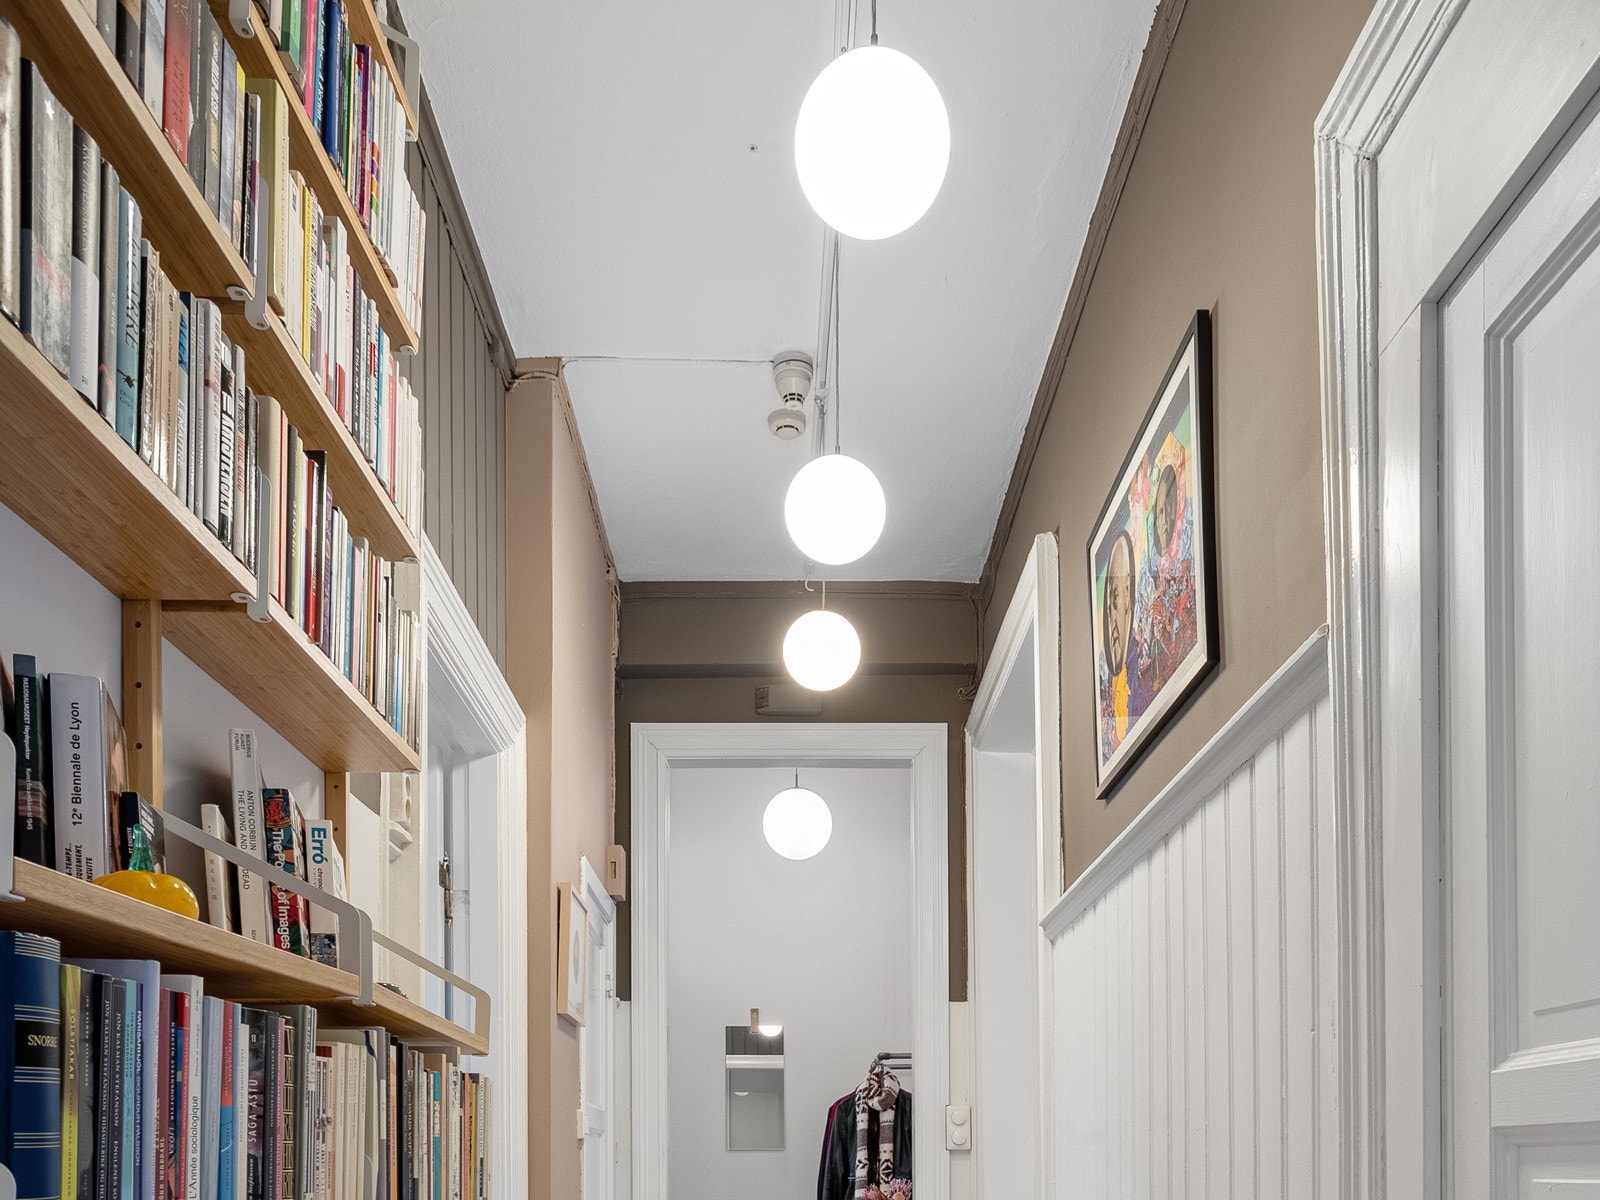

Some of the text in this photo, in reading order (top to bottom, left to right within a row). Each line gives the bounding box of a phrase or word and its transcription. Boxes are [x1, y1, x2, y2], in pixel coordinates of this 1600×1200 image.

[178, 313, 189, 370] ALEX
[69, 702, 82, 804] Biennale de Lyon
[237, 789, 250, 890] THE LIVING AND DEAD
[246, 790, 257, 851] ANTON CORBIJN
[311, 827, 328, 865] Erró
[272, 828, 291, 949] The of Images
[189, 1095, 199, 1200] L'Année sociologique
[248, 1114, 257, 1143] SAGA
